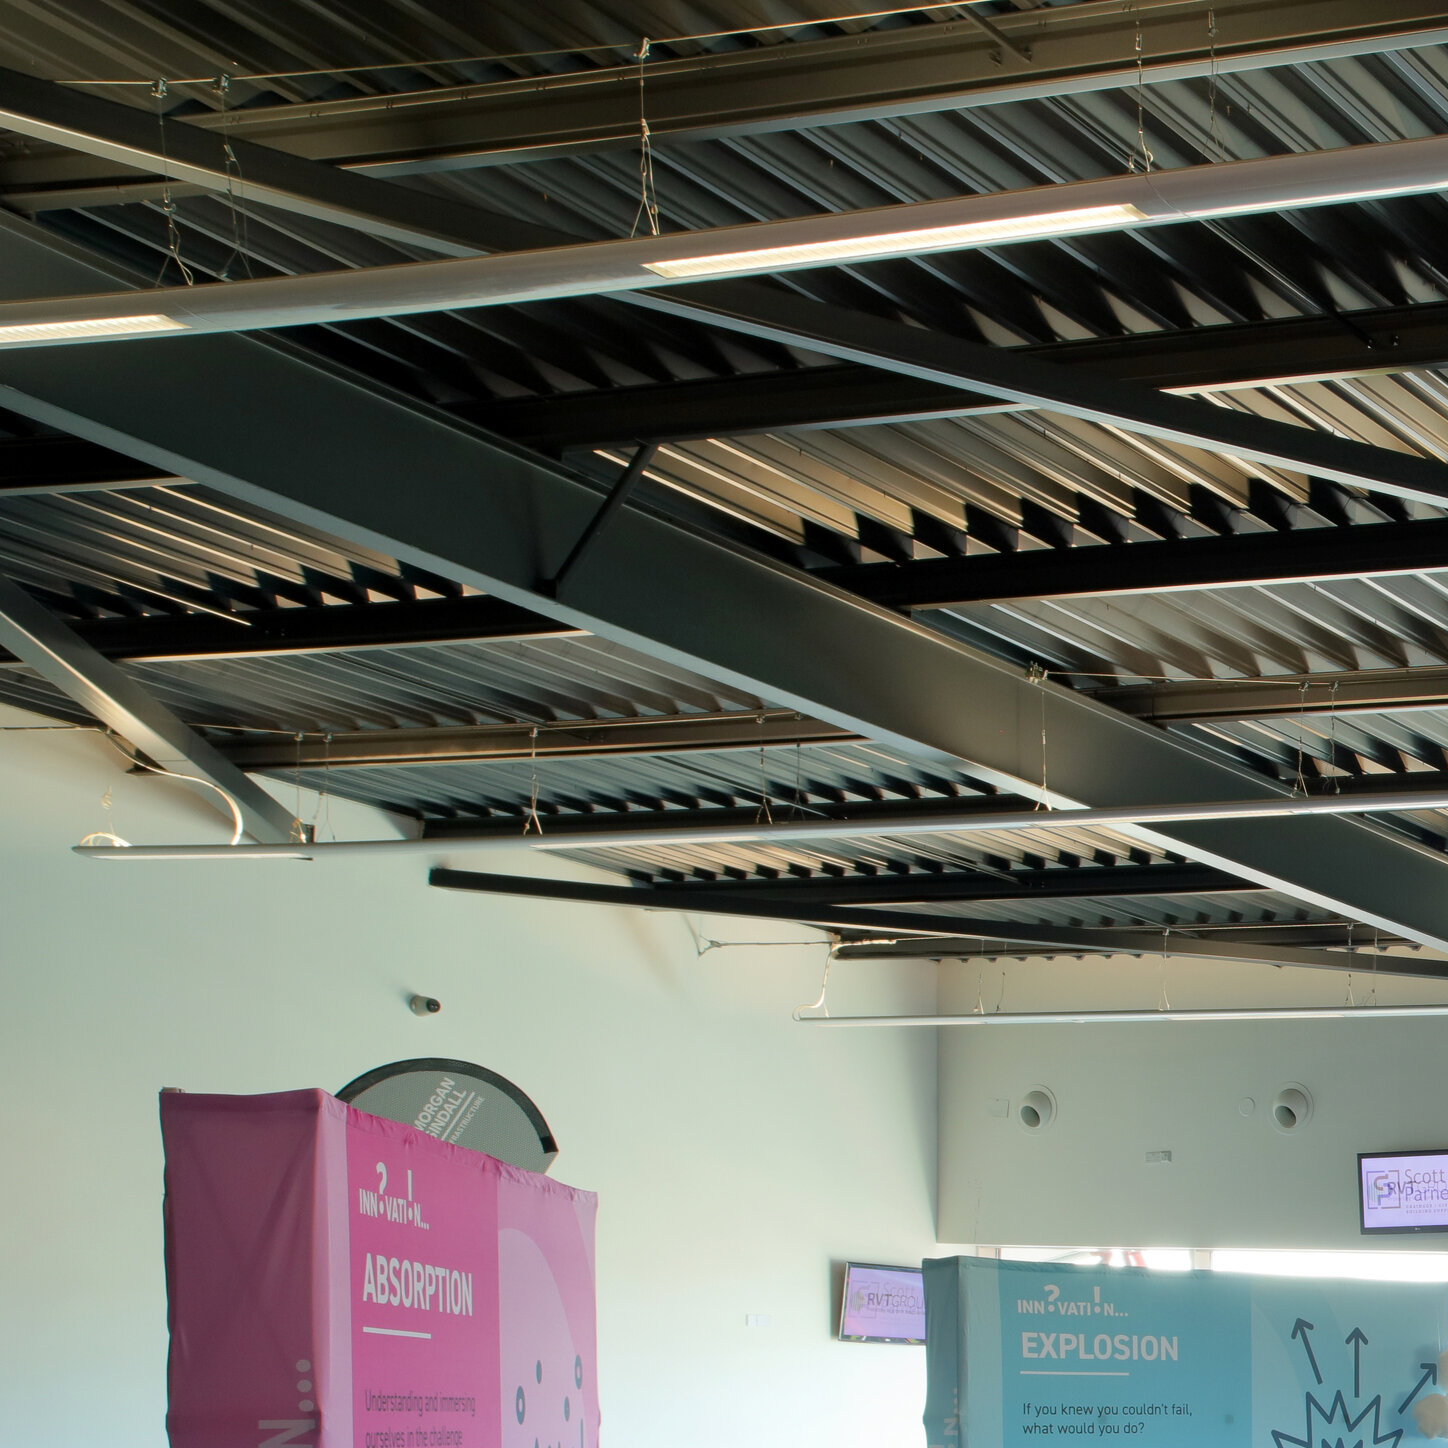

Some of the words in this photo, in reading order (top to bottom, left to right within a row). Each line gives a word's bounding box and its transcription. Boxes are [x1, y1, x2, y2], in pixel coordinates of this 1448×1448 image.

[414, 1077, 455, 1131] MORGAN
[1405, 1169, 1445, 1184] Scott
[363, 1253, 472, 1317] ABSORPTION
[867, 1293, 925, 1309] RVTGROU
[1022, 1332, 1178, 1360] EXPLOSION
[365, 1390, 422, 1417] Understanding
[425, 1391, 438, 1412] and
[440, 1391, 475, 1417] immersing
[1023, 1403, 1031, 1415] If
[1035, 1405, 1057, 1418] you
[1061, 1404, 1093, 1415] knew
[1098, 1405, 1118, 1418] you
[1122, 1404, 1168, 1415] couldn't
[1172, 1404, 1192, 1416] fail,
[366, 1427, 405, 1448] ourselves
[407, 1426, 413, 1447] in
[416, 1426, 427, 1447] the
[1023, 1423, 1054, 1434] what
[1057, 1422, 1095, 1434] would
[1099, 1425, 1120, 1436] you
[1124, 1422, 1144, 1434] do?
